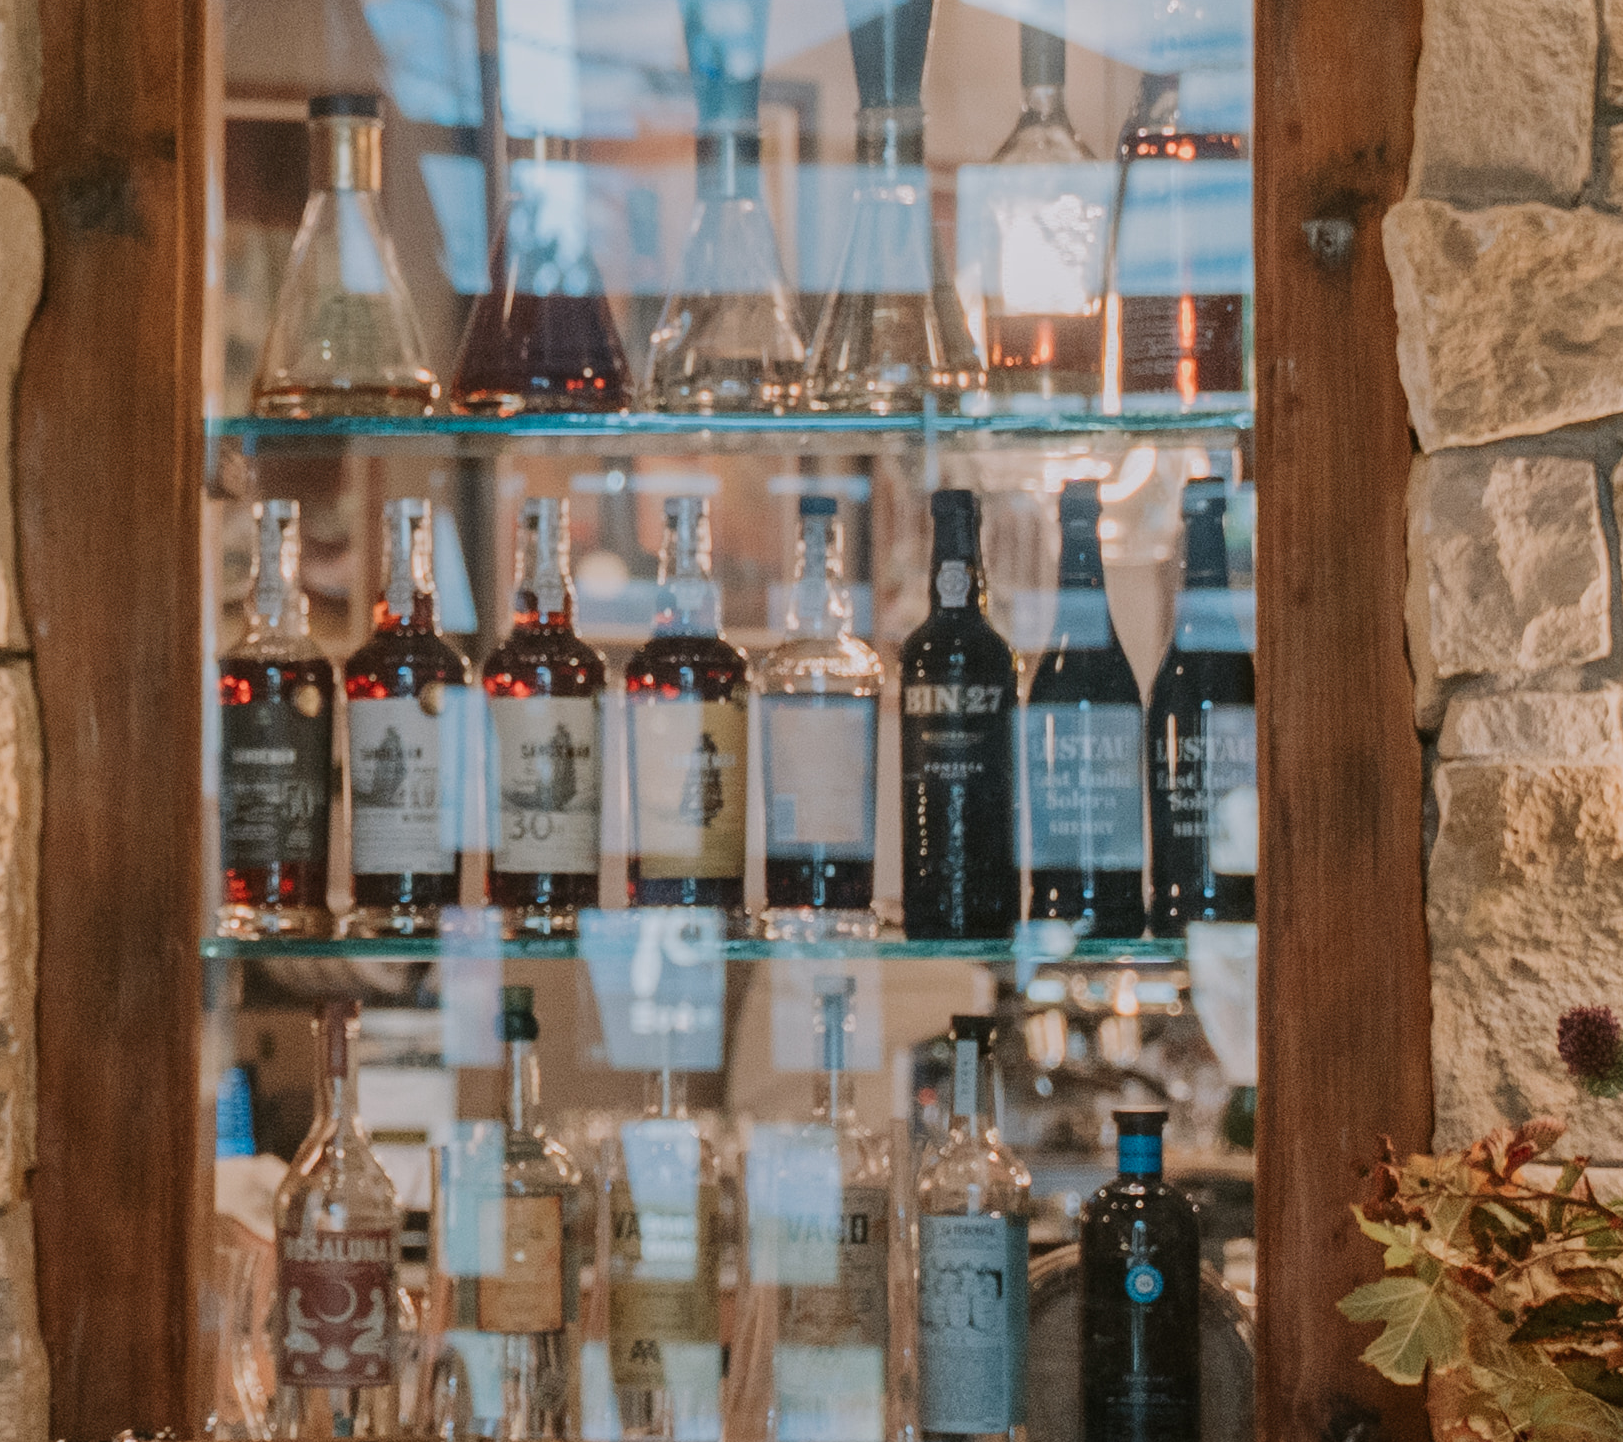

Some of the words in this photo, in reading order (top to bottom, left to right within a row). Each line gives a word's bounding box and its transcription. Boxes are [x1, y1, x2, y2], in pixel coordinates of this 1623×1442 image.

[904, 684, 960, 714] BIN
[965, 684, 1004, 714] 27
[508, 814, 553, 840] 30
